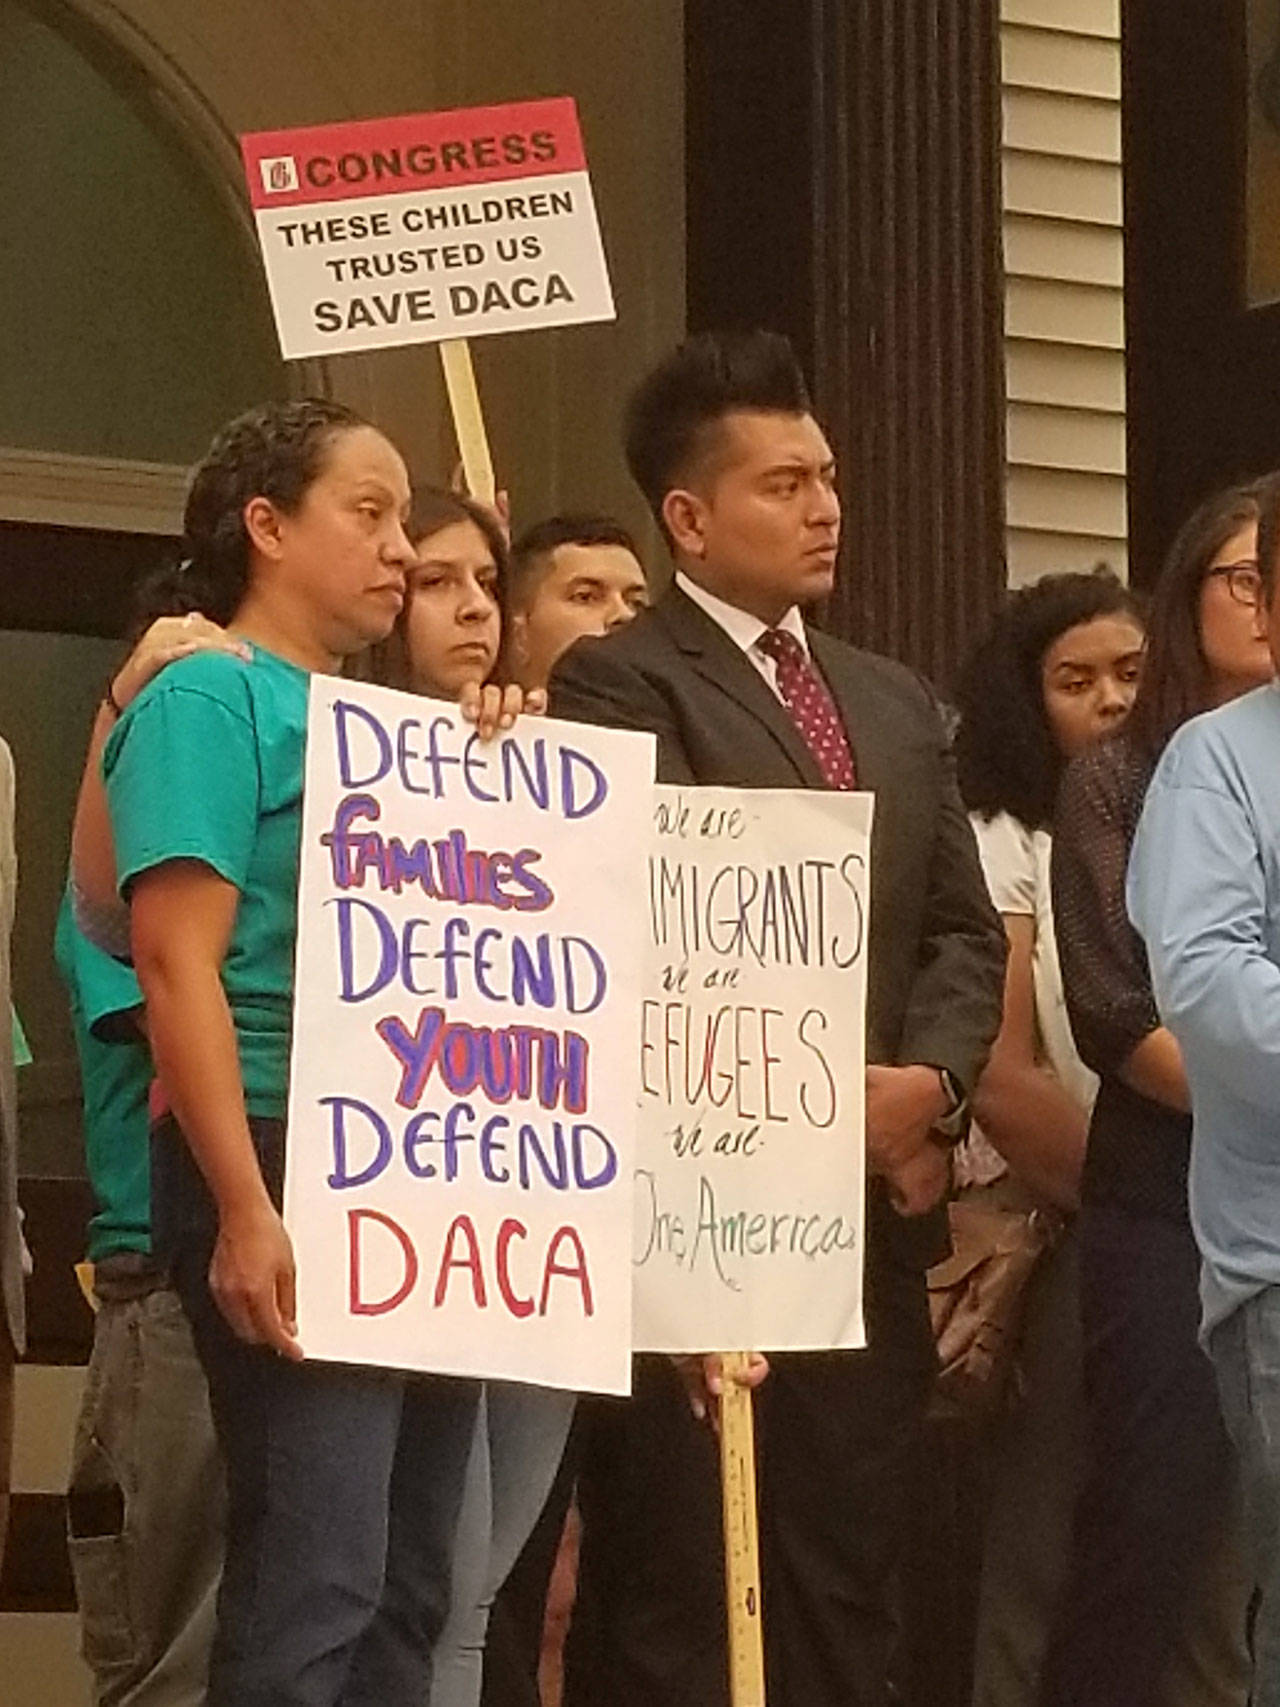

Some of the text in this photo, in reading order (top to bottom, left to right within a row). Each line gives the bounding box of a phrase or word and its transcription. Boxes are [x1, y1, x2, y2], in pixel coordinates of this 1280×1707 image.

[305, 130, 557, 188] CONGRESS
[277, 191, 574, 247] THESE CHILDREN
[326, 235, 542, 282] TRUSTED US
[314, 273, 574, 332] SAVE DACA
[375, 1006, 590, 1115] YOUTH
[636, 999, 836, 1128] EFUGEES
[347, 1208, 594, 1318] DACA
